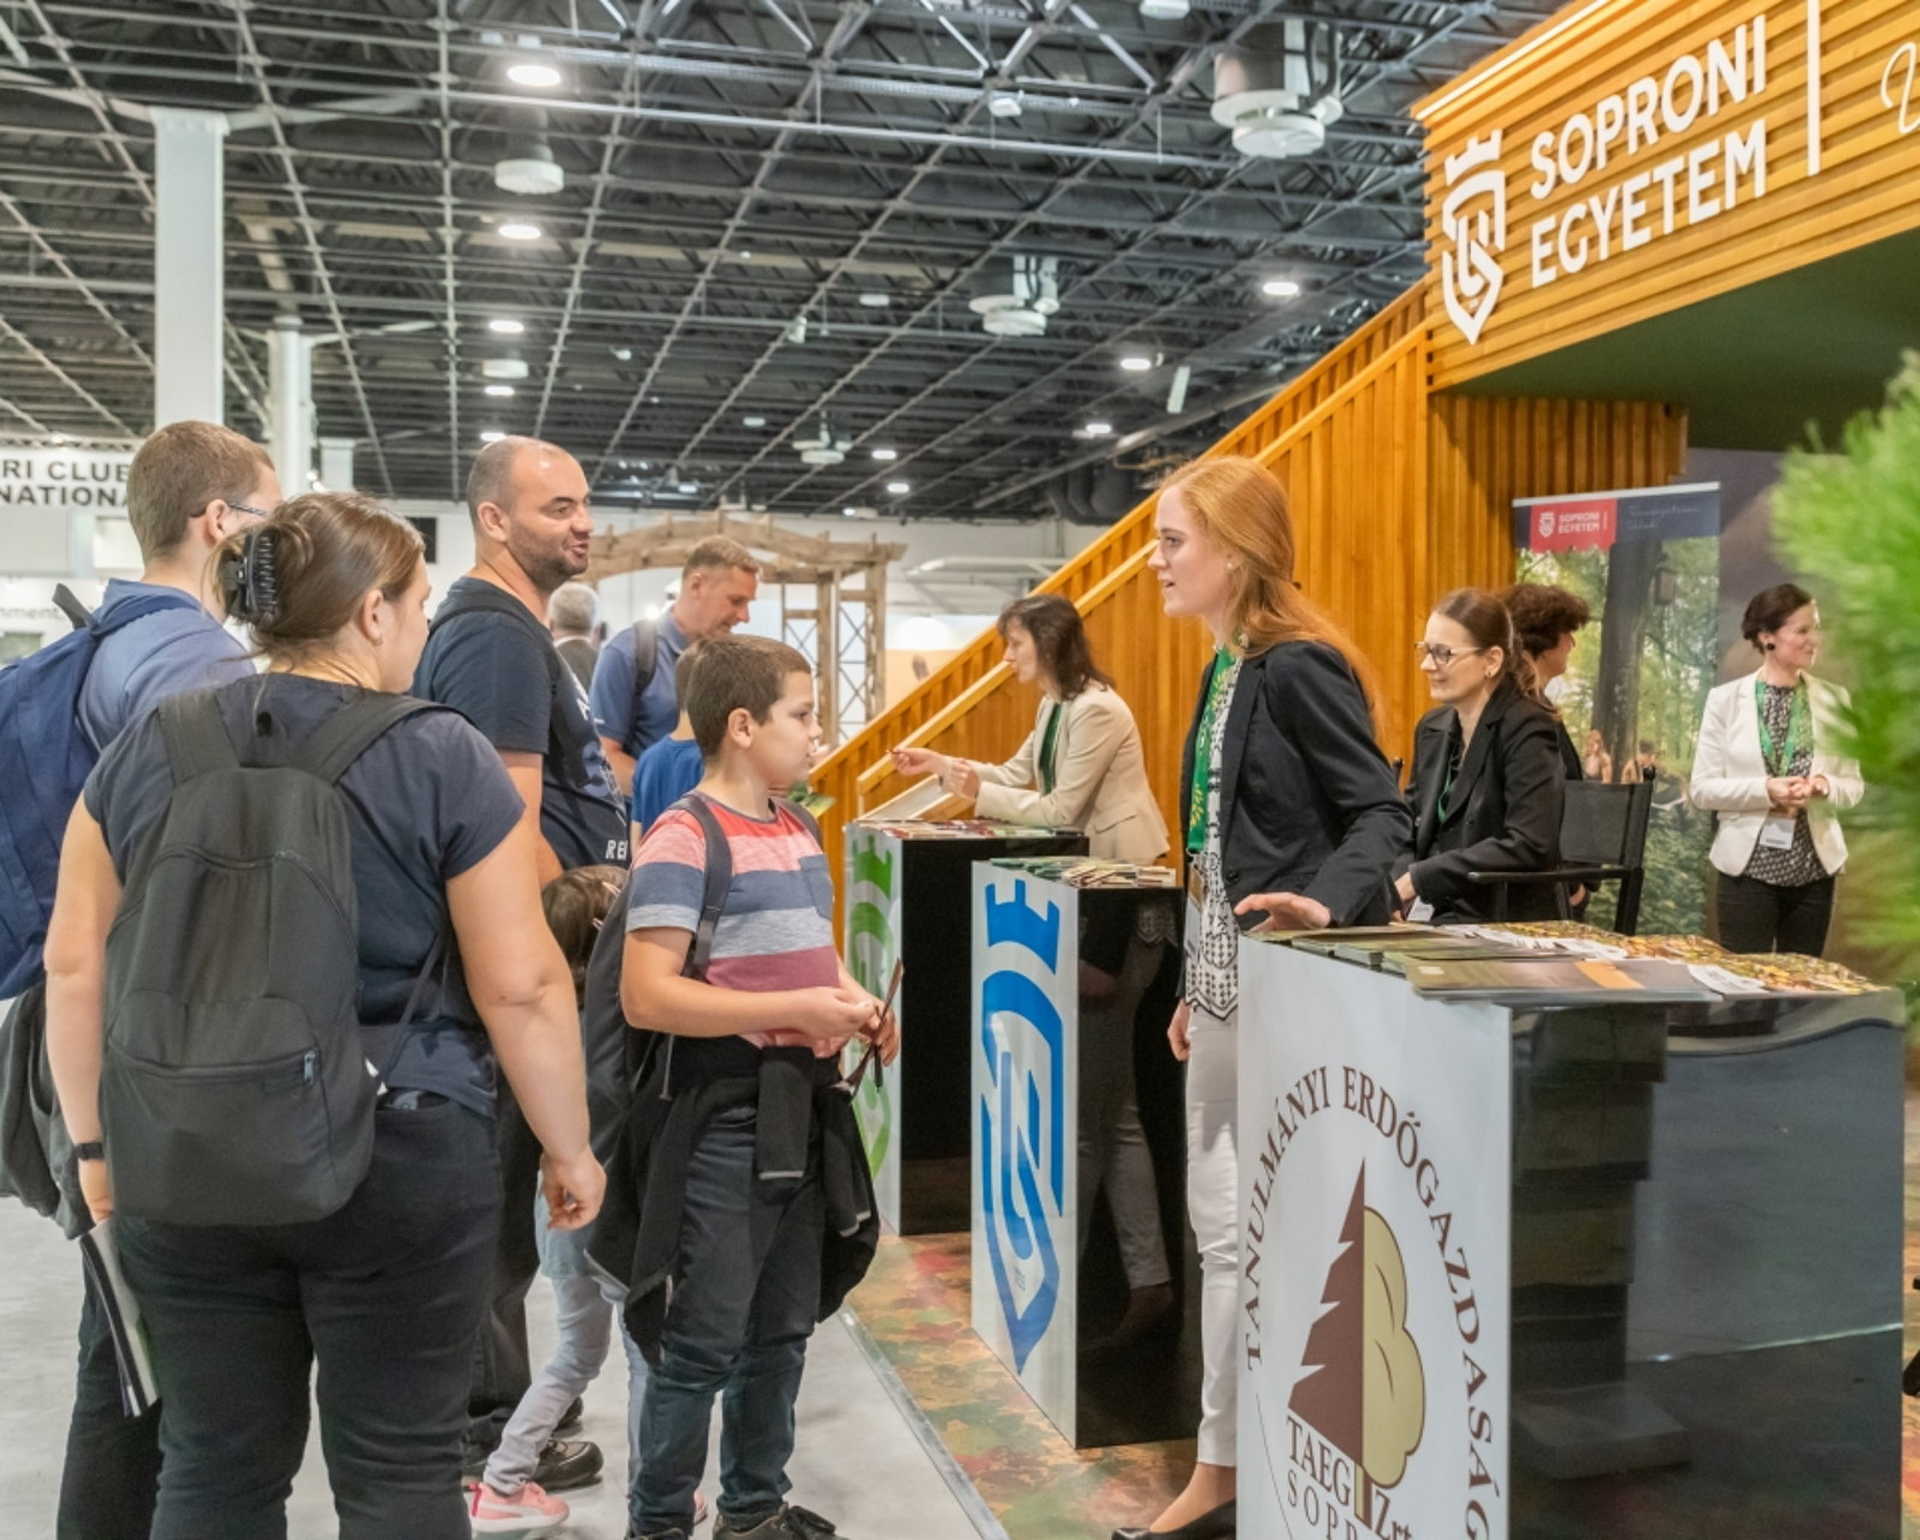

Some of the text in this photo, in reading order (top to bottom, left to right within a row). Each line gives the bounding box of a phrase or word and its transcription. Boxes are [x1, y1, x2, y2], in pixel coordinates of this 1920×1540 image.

[1530, 14, 1767, 199] SOPRONI
[1531, 119, 1767, 289] EGYETEM
[1244, 1065, 1332, 1371] TANULMÁNYI
[1287, 1415, 1351, 1506] TAEG
